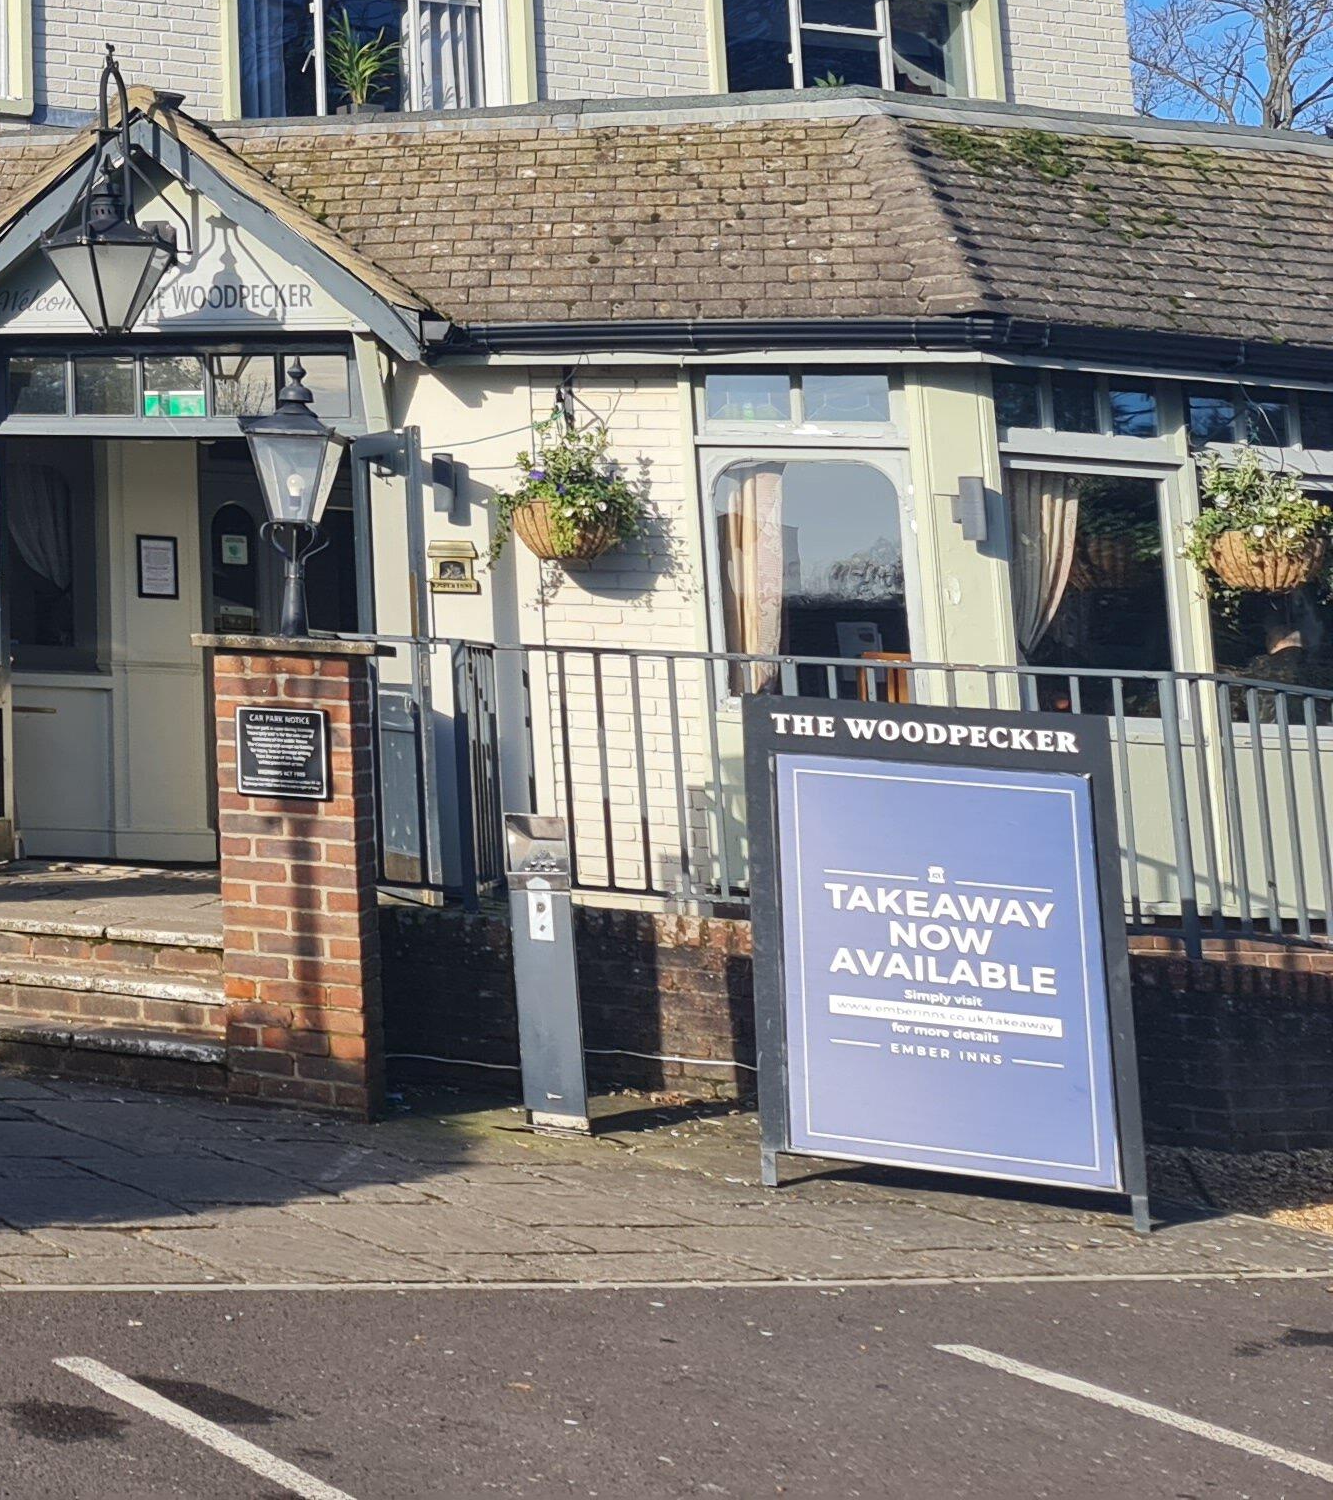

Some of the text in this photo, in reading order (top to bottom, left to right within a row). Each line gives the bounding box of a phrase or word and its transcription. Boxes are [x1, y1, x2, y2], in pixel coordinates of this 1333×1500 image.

[172, 283, 313, 311] WOODPECKER
[249, 713, 264, 722] CAR
[265, 714, 284, 724] PARK
[770, 712, 1080, 754] THE WOODPECKER
[824, 882, 1055, 929] TAKEAWAY
[889, 920, 993, 956] NOW
[829, 947, 1057, 996] AVAILABLE
[903, 989, 983, 1008] Simply visit
[891, 1021, 1000, 1044] for more details
[889, 1042, 1004, 1066] EMBER INNS
